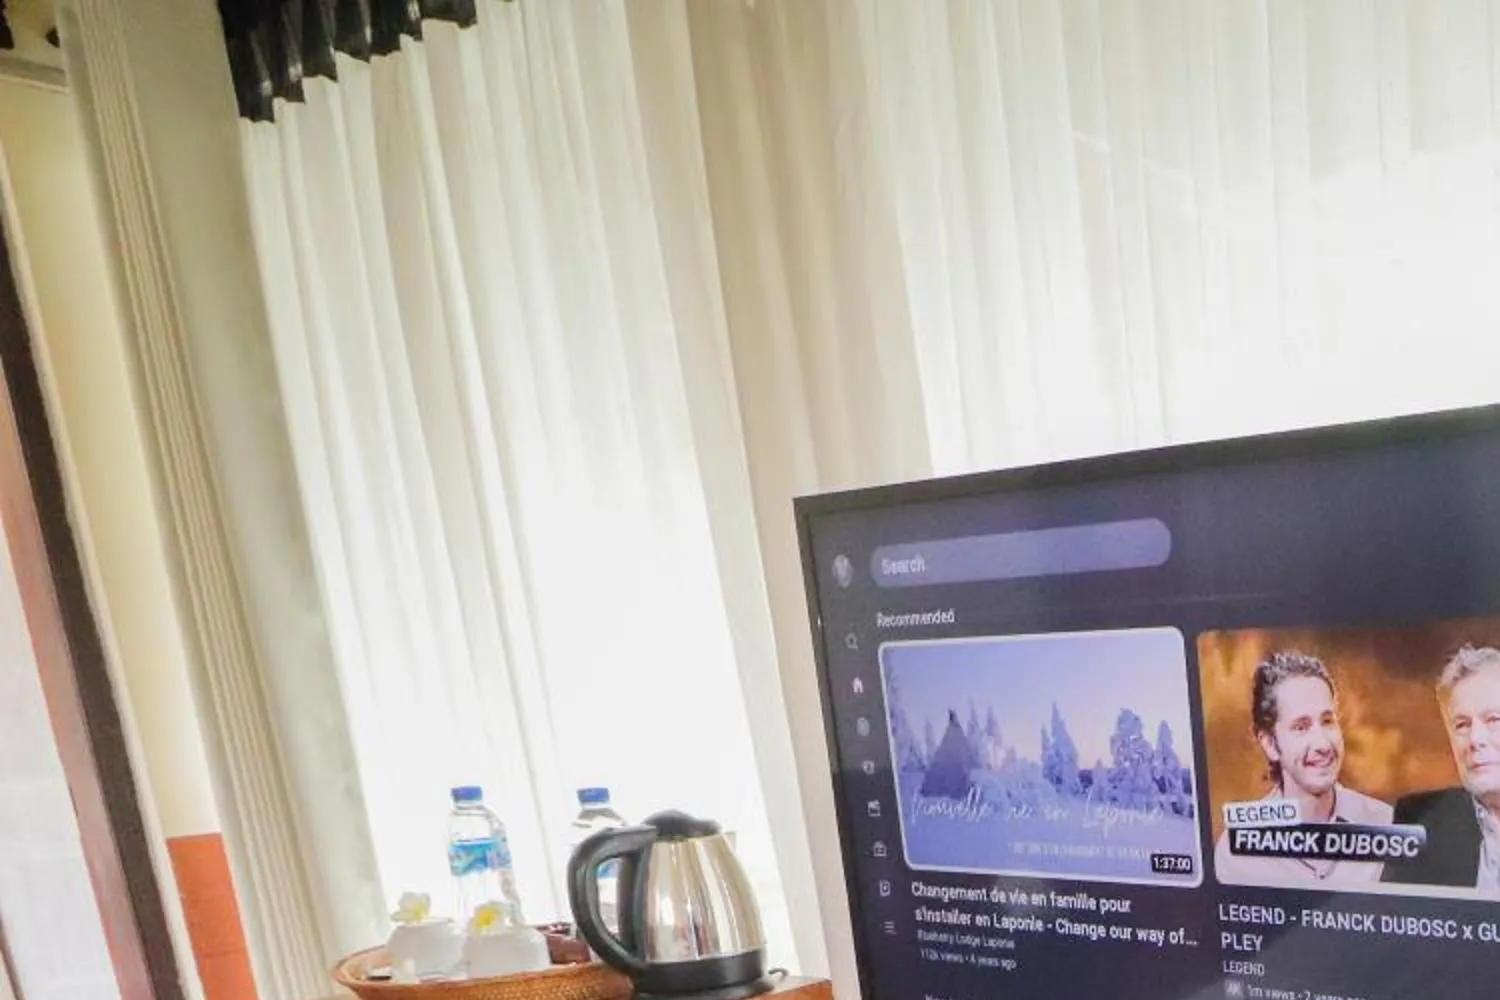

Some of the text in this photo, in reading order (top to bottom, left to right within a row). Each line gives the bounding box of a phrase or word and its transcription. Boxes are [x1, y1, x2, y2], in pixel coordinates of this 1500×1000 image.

[881, 553, 925, 576] Search
[876, 607, 955, 628] Recommended
[1227, 803, 1296, 824] LEGEND
[1235, 829, 1420, 858] FRANCK DUBOSC
[1154, 856, 1191, 872] 1:37:00
[911, 881, 1132, 915] Changement de vie en famille pour
[914, 904, 972, 926] s'installer
[975, 913, 991, 928] en
[993, 911, 1044, 933] Laponie
[1055, 918, 1107, 941] Change
[1109, 926, 1133, 941] our
[1136, 927, 1165, 947] way
[1218, 903, 1286, 925] LEGEND
[1301, 909, 1376, 933] FRANCK
[1381, 915, 1457, 939] DUBOSC
[1462, 925, 1473, 940] x
[1221, 931, 1263, 952] PLEY
[1222, 959, 1265, 977] LEGEND
